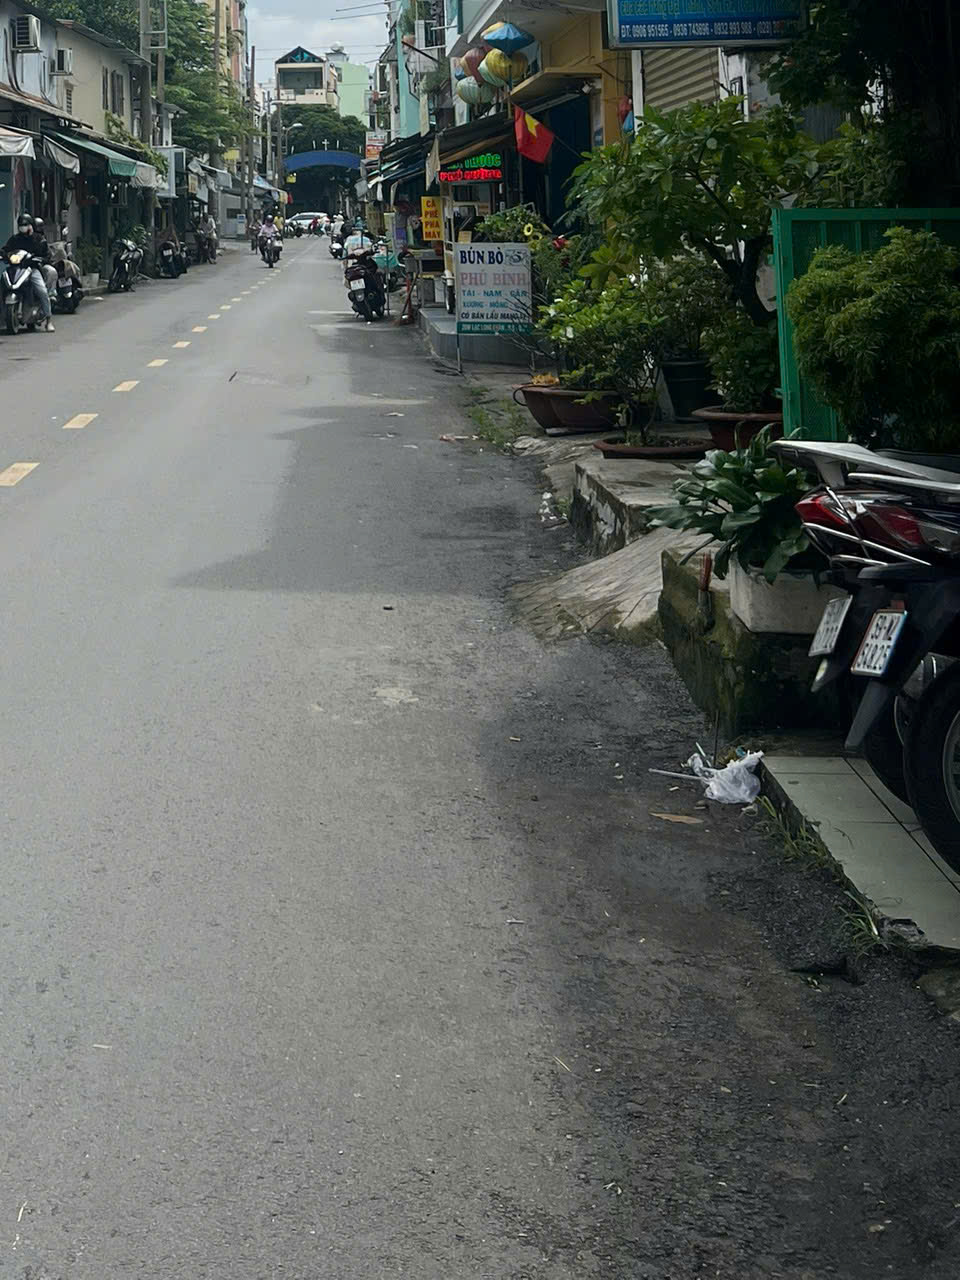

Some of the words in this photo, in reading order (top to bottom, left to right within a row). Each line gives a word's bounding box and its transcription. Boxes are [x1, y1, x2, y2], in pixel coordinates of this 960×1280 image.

[459, 247, 485, 265] BÚN
[488, 246, 504, 265] BÒ
[460, 269, 487, 286] PHÚ
